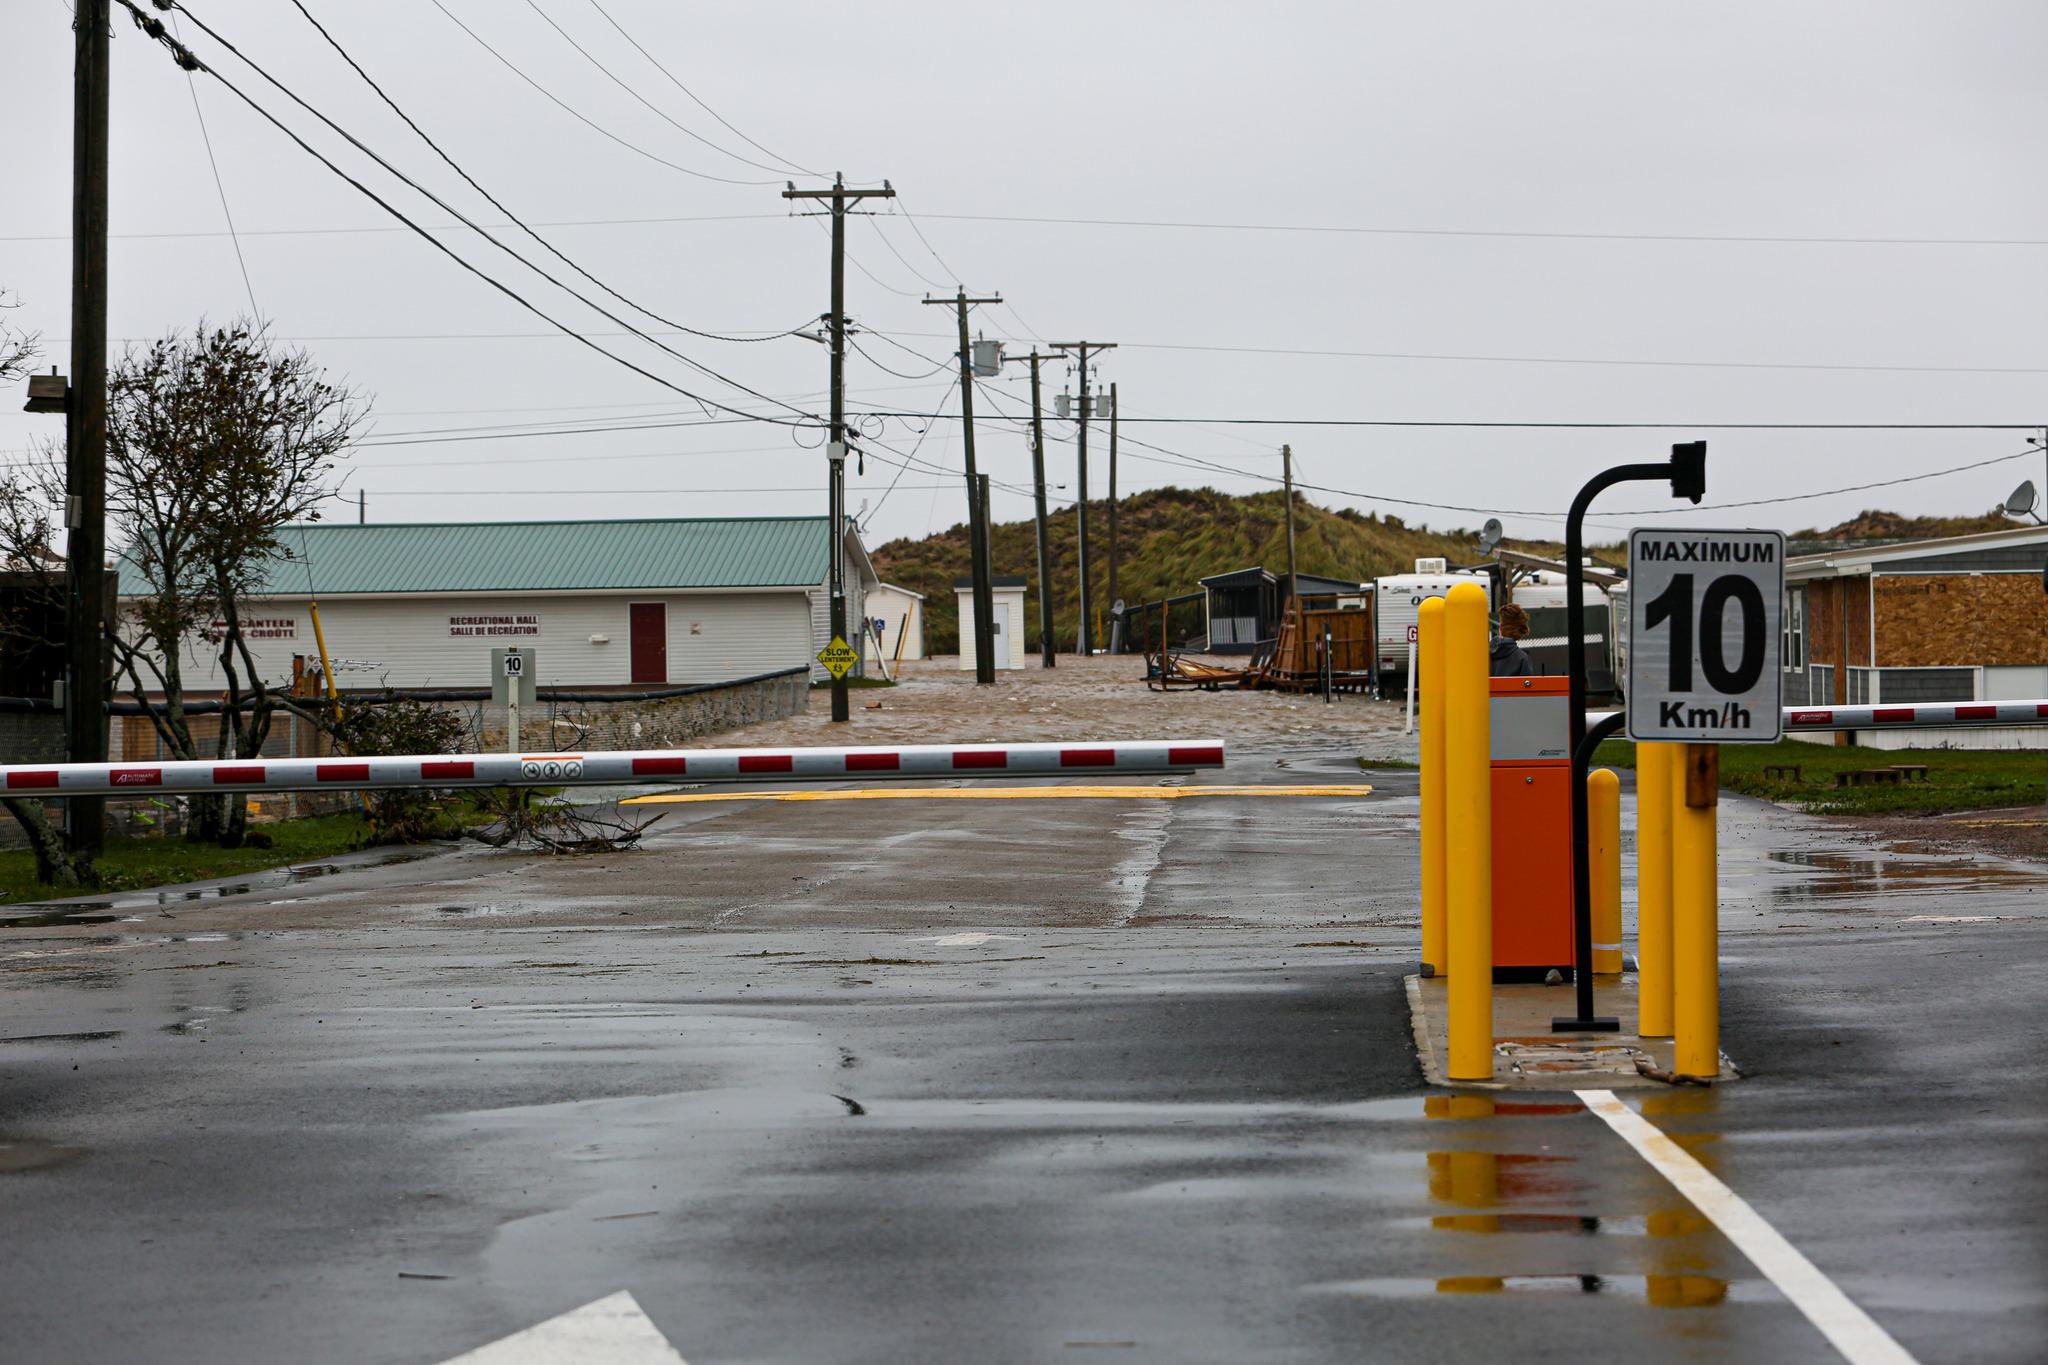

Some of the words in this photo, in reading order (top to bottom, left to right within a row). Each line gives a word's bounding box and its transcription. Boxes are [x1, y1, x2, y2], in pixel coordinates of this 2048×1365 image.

[1640, 541, 1774, 563] MAXIMUM
[238, 619, 294, 628] CANTEEN
[450, 616, 514, 625] RECREATIONAL
[516, 616, 538, 624] HALL
[450, 627, 473, 635] SALLE
[475, 627, 486, 635] DE
[1645, 573, 1766, 695] 10
[826, 648, 850, 656] SLOW
[505, 657, 522, 671] 10
[1659, 701, 1751, 729] Km/h
